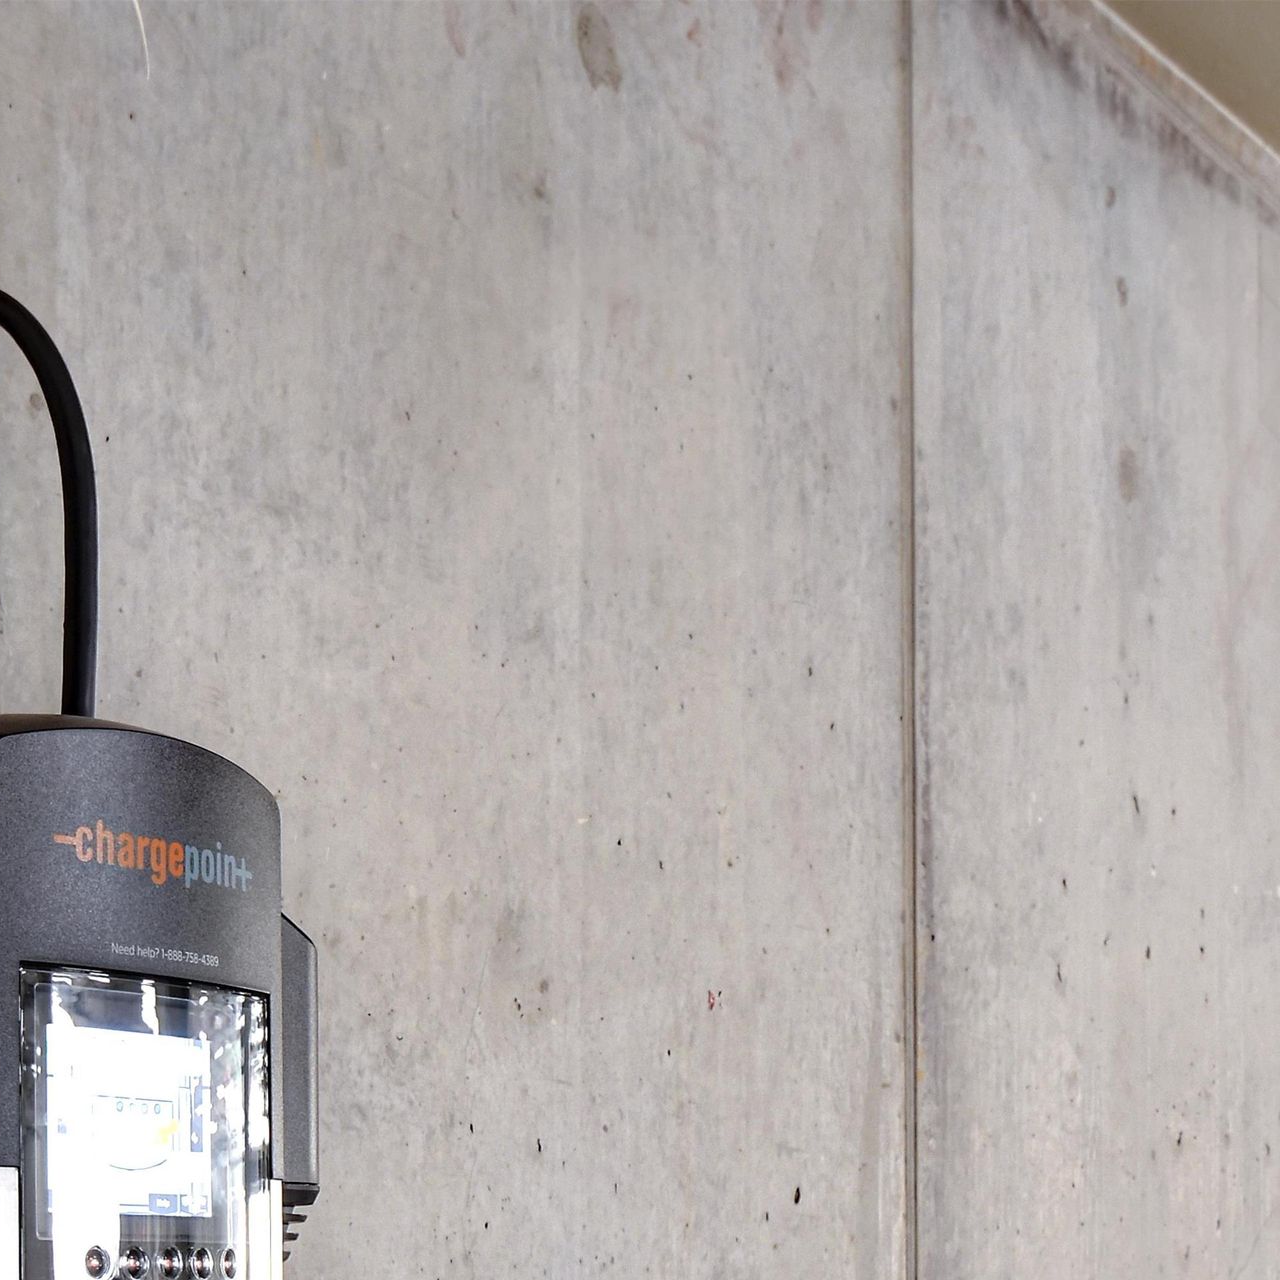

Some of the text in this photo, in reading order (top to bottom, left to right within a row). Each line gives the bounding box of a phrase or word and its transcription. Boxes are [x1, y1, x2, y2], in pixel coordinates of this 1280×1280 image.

[111, 942, 219, 967] Need help? 1-888-758-4389
